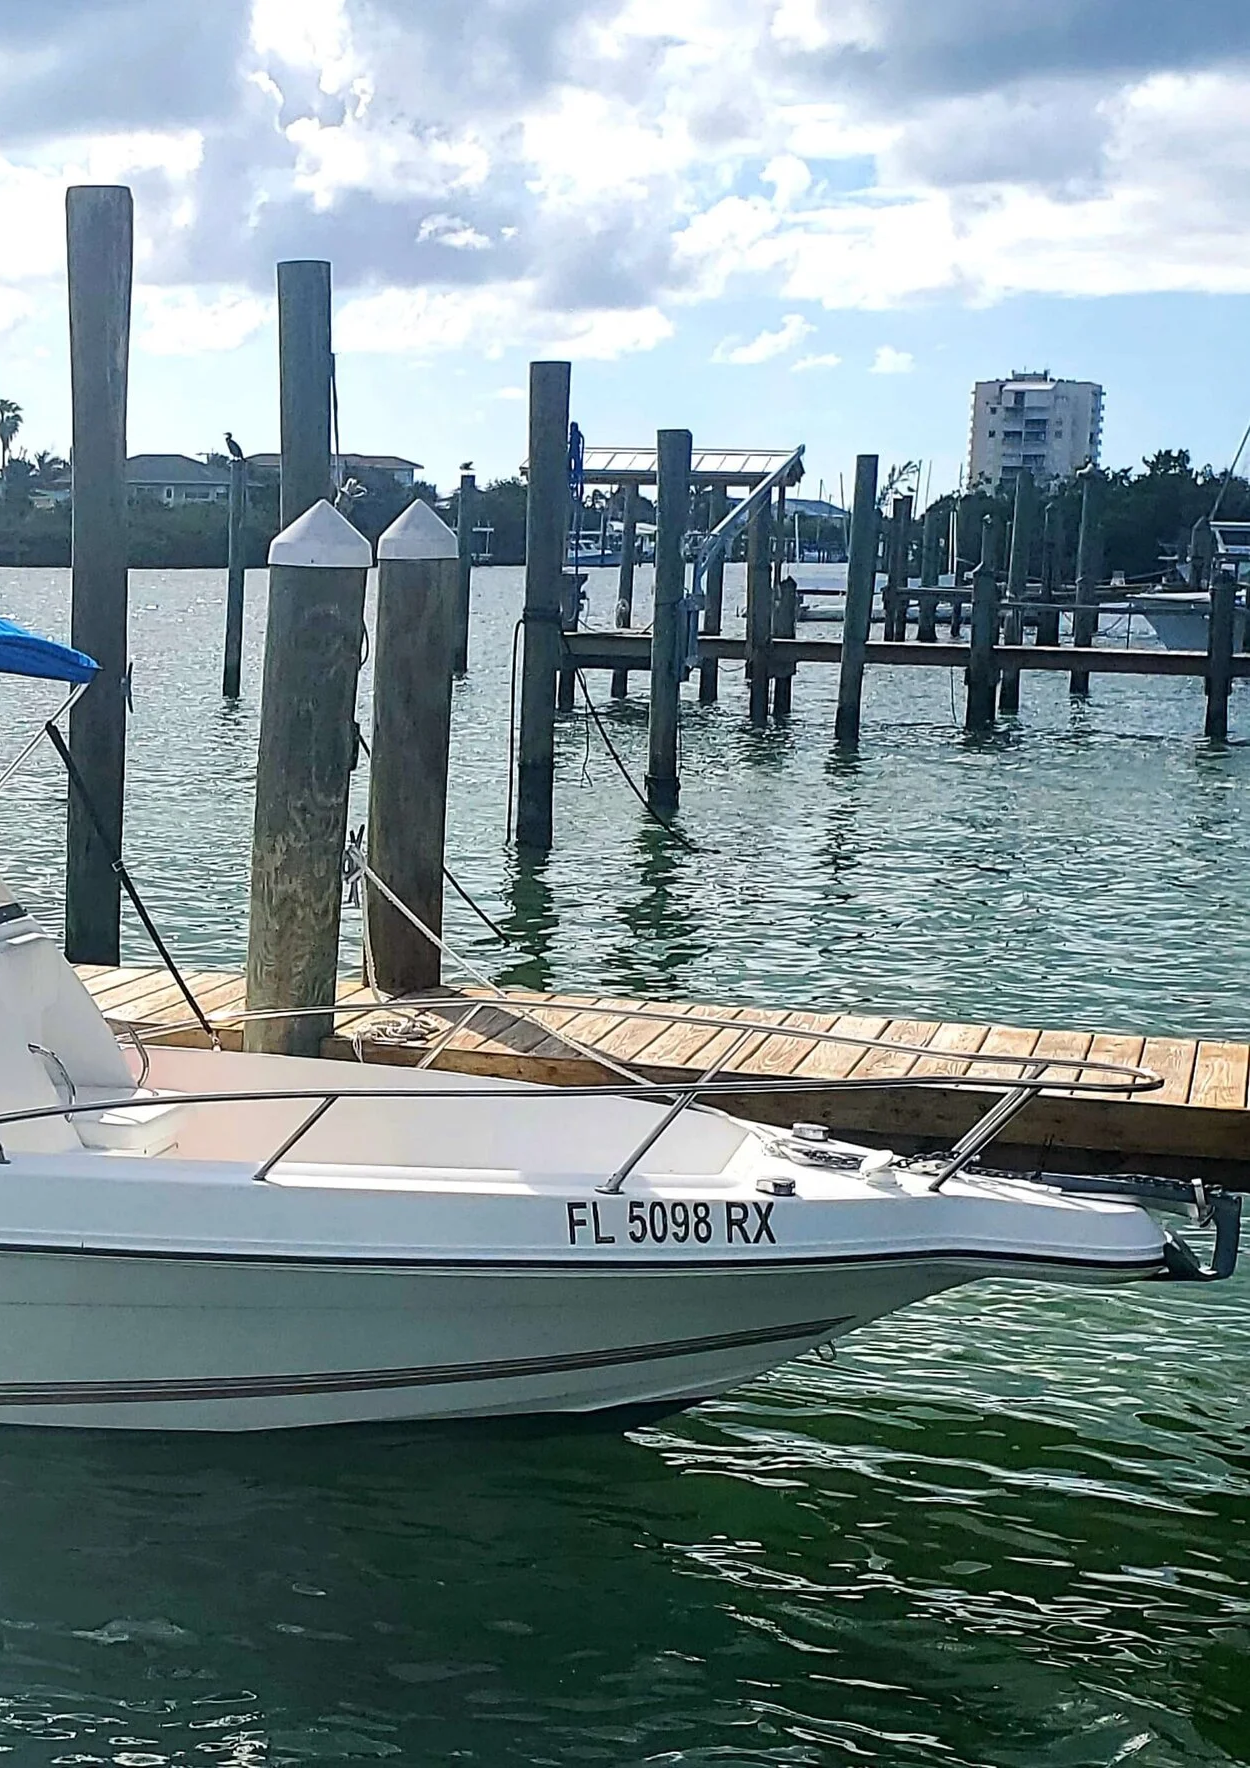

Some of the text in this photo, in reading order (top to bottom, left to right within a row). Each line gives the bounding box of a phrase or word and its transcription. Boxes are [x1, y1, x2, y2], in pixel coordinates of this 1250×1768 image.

[566, 1201, 777, 1245] FL 5098 RX
